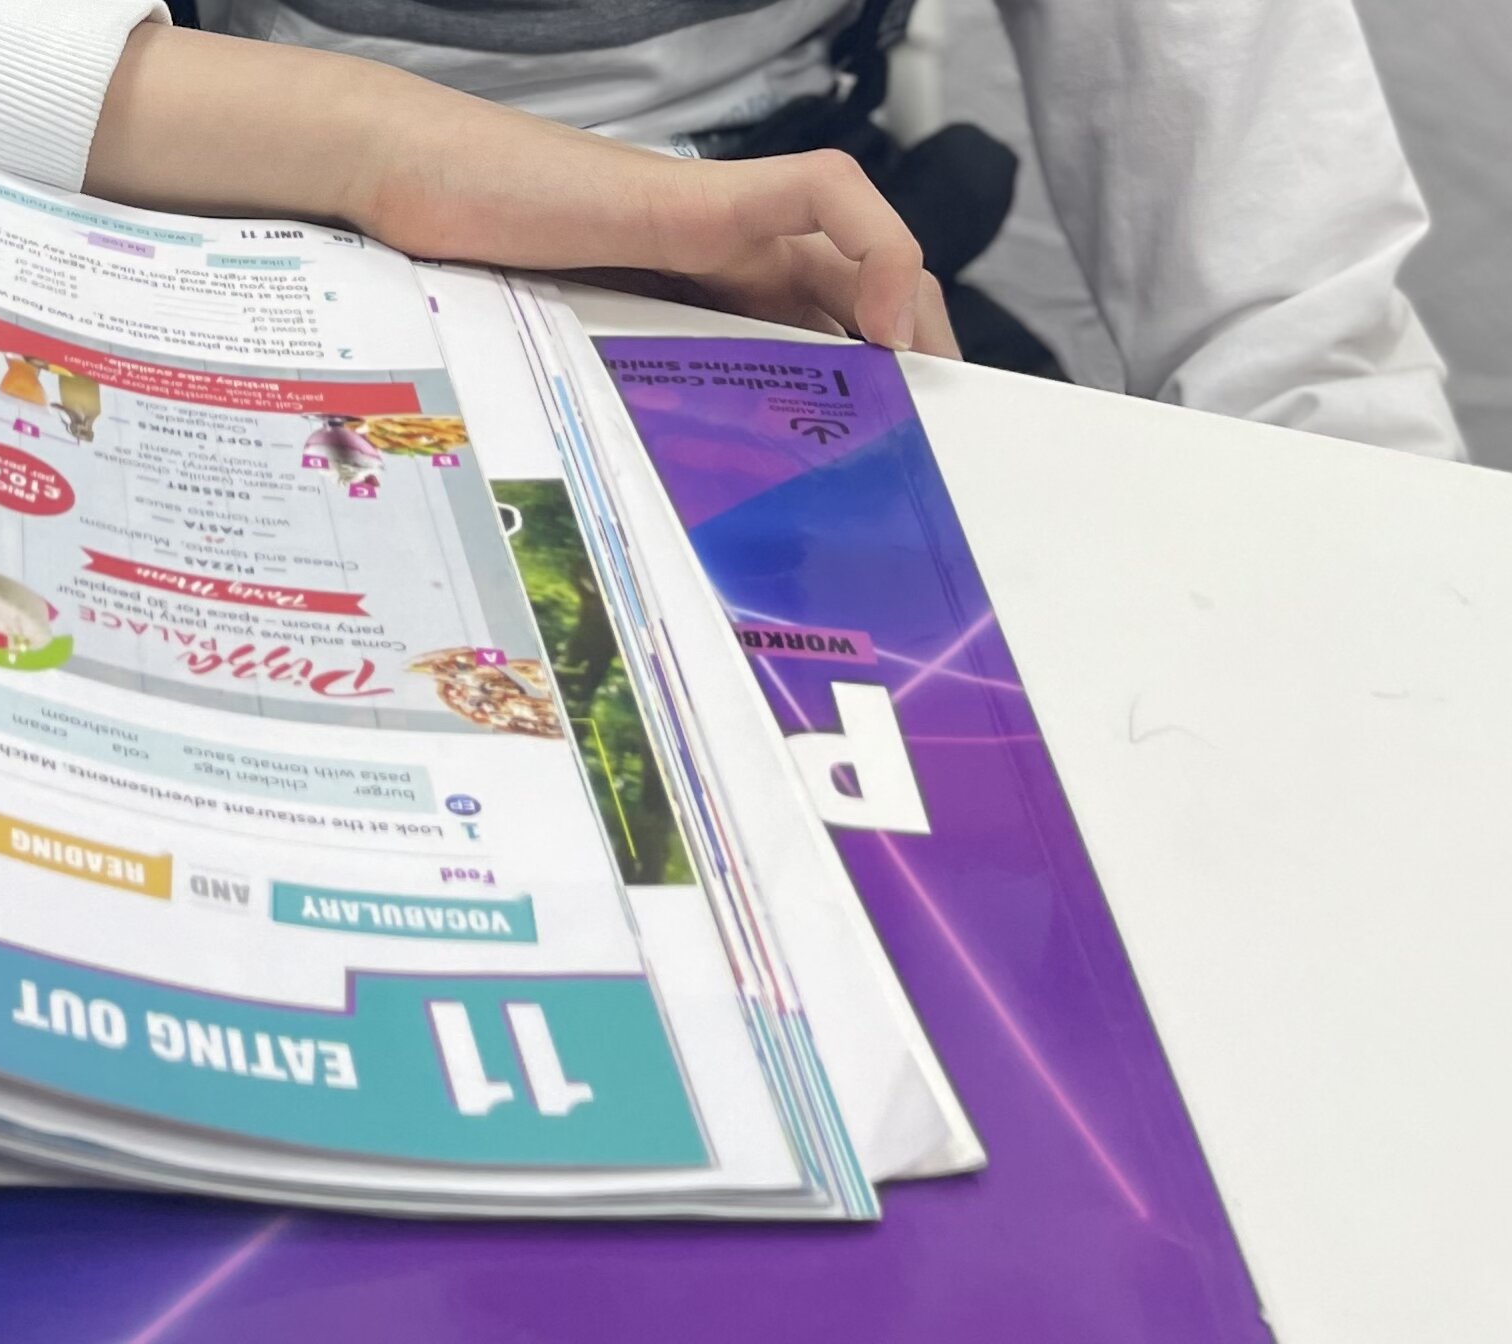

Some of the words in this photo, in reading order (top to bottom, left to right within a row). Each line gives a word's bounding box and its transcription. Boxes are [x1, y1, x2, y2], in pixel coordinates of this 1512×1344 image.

[240, 229, 260, 240] 11
[265, 228, 304, 240] UNIT
[177, 371, 210, 385] cake
[621, 372, 705, 387] Cooke
[690, 361, 822, 380] Catherine
[215, 374, 279, 391] Birthday
[713, 373, 828, 395] Caroline
[137, 421, 207, 441] DRINKS
[215, 433, 263, 448] SOFT
[29, 468, 56, 485] per
[166, 480, 250, 500] DESSERT
[183, 519, 244, 537] PASTA
[183, 556, 255, 575] PIZZAS
[135, 567, 220, 598] Menu
[56, 584, 86, 602] our
[226, 582, 307, 609] Party
[91, 596, 107, 610] in
[112, 601, 154, 622] here
[147, 596, 168, 611] 30
[175, 603, 200, 620] for
[160, 612, 207, 631] party
[207, 608, 260, 625] space
[78, 605, 217, 652] PALACE
[214, 622, 255, 638] your
[282, 619, 331, 633] room
[337, 620, 385, 637] party
[261, 630, 305, 646] have
[310, 634, 345, 648] and
[352, 638, 407, 652] Come
[176, 644, 394, 698] Pizza
[12, 714, 68, 739] cream
[41, 707, 138, 743] mushroom
[0, 743, 56, 770] Match
[112, 744, 149, 761] cola
[183, 745, 235, 763] sauce
[783, 681, 930, 834] P
[193, 762, 230, 780] legs
[241, 756, 308, 775] tomato
[314, 766, 355, 780] with
[237, 770, 307, 791] chicken
[360, 769, 411, 785] pasta
[63, 763, 217, 810] advertisements.
[353, 784, 415, 801] burger
[224, 802, 325, 826] restaurant
[450, 798, 475, 812] EP
[332, 818, 363, 832] the
[369, 821, 388, 833] at
[395, 823, 443, 838] Look
[11, 827, 145, 884] READING
[439, 866, 496, 885] Food
[189, 874, 250, 906] AND
[301, 895, 511, 934] VOCABULARY
[13, 980, 128, 1048] OUT
[146, 1011, 358, 1089] EATING
[429, 1002, 593, 1116] 11
